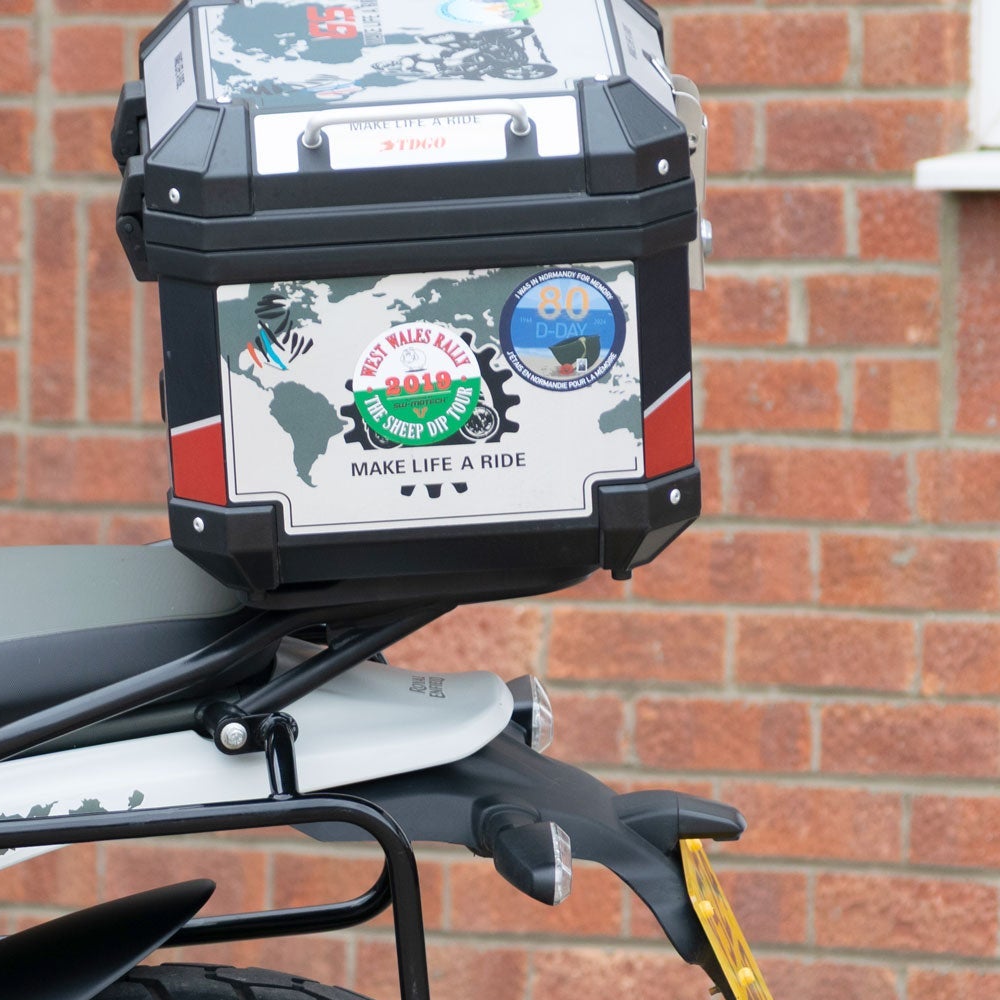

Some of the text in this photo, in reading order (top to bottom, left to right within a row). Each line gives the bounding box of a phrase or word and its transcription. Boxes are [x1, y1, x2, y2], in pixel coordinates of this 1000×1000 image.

[350, 120, 387, 131] MAKE
[432, 115, 441, 126] A
[516, 282, 532, 298] WAS
[530, 277, 539, 286] IN
[538, 270, 577, 282] NORMANDY
[577, 272, 590, 281] FOR
[589, 277, 614, 300] MEMORY
[537, 284, 590, 320] 80
[535, 322, 588, 338] D-DAY
[360, 328, 471, 377] WEST WALES RALLY
[385, 371, 452, 397] 2019
[522, 368, 532, 380] EN
[530, 373, 568, 389] NORMANDIE
[568, 378, 586, 389] POUR
[586, 374, 597, 383] LA
[364, 386, 473, 439] THE SHEEP DIP TOUR
[351, 452, 526, 477] MAKE LIFE A RIDE
